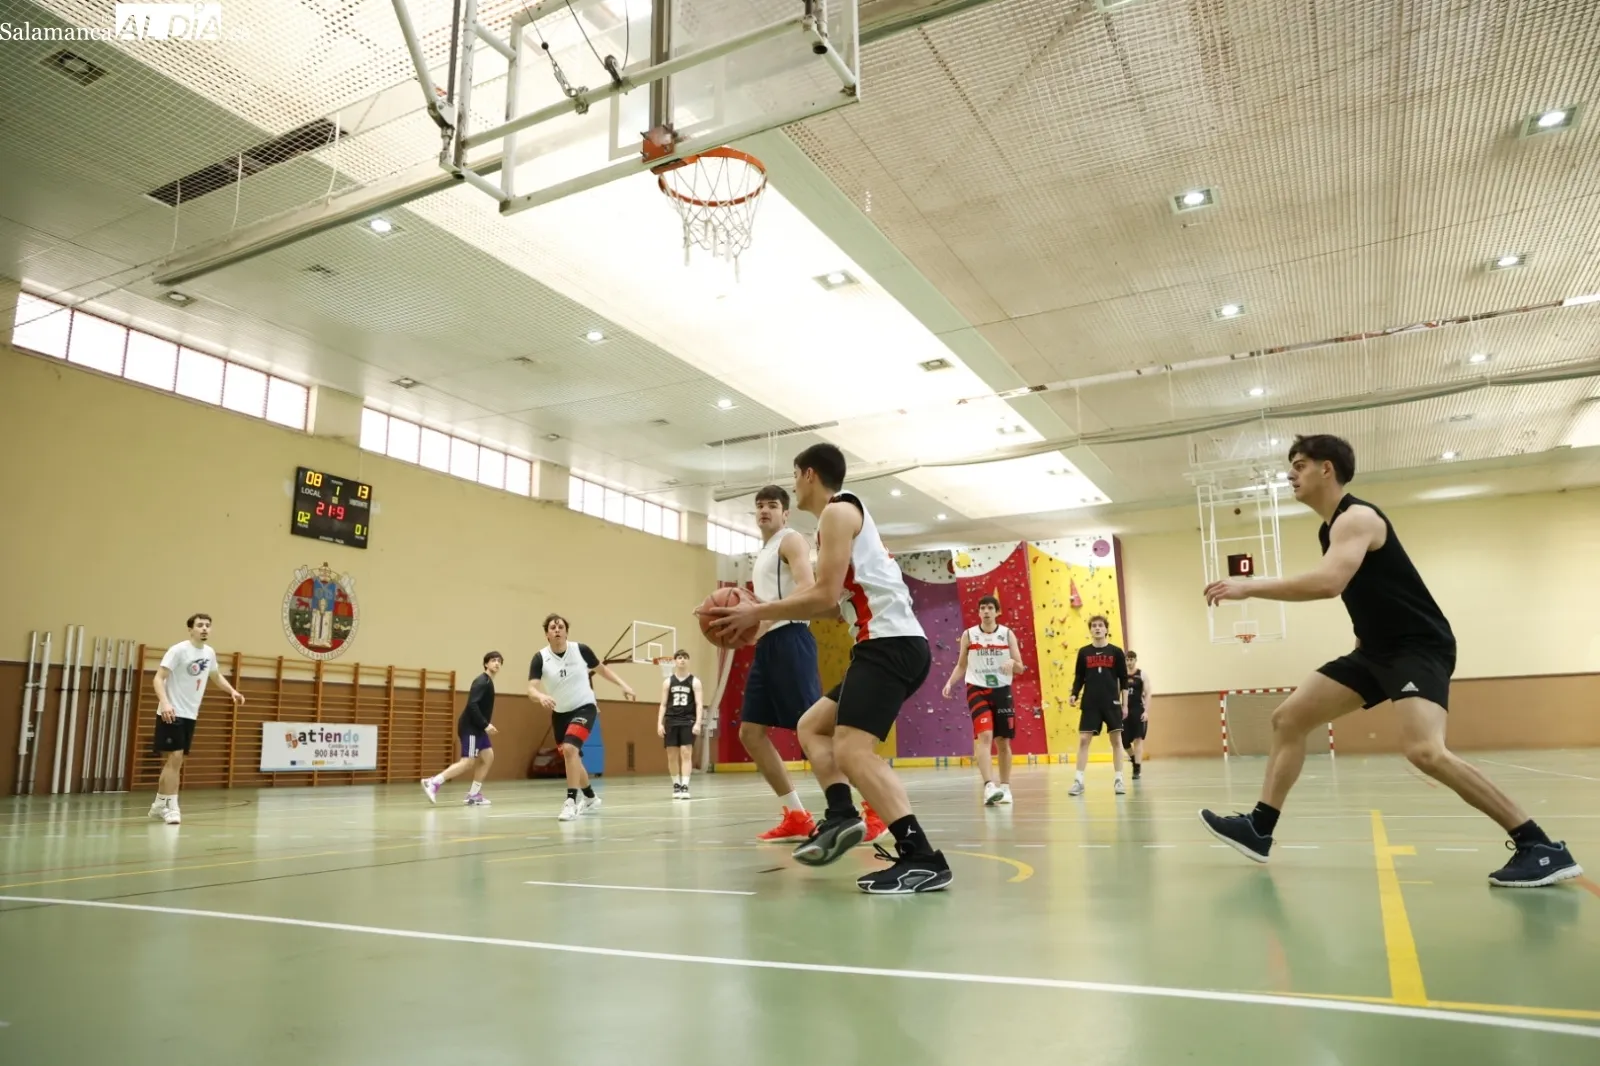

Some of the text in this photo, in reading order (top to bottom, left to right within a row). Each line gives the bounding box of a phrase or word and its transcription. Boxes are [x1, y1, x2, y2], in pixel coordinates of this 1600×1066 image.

[306, 471, 322, 487] 08
[301, 487, 321, 497] LOCAL
[336, 485, 340, 496] 1
[357, 484, 369, 500] 13
[297, 511, 311, 524] 02
[354, 524, 367, 536] 01
[1240, 559, 1249, 572] 0
[559, 669, 567, 678] 21
[672, 692, 688, 706] 23
[298, 727, 359, 744] atiendo
[314, 749, 327, 757] 900
[329, 749, 338, 757] 84
[340, 749, 350, 757] 74
